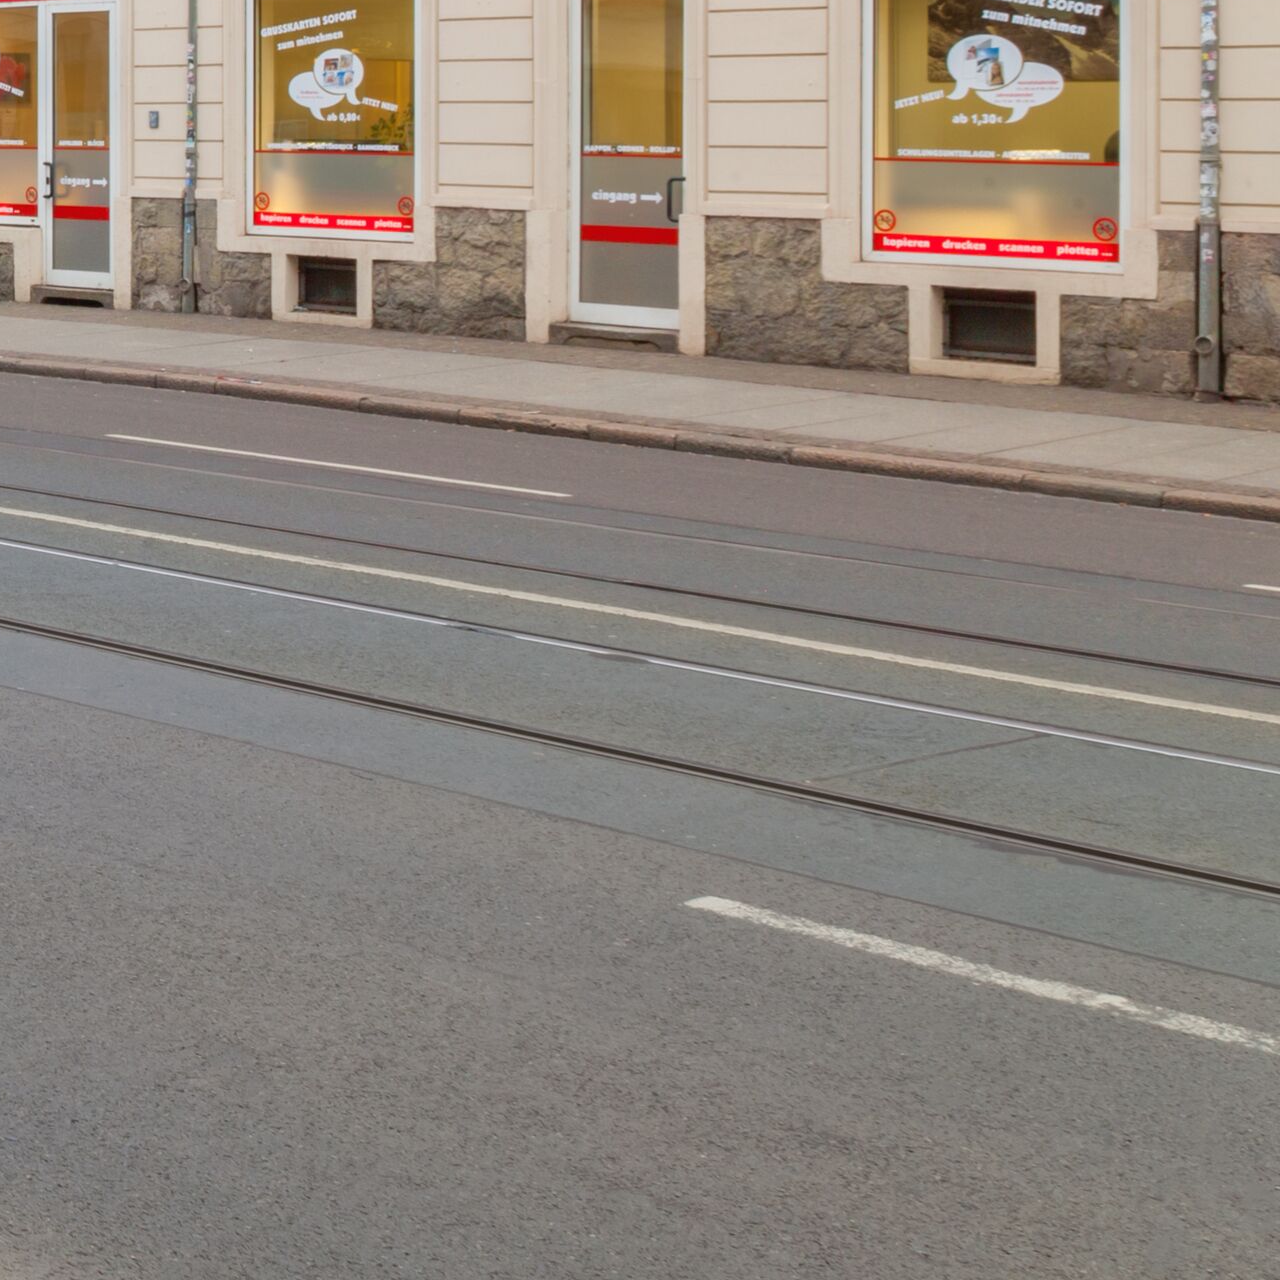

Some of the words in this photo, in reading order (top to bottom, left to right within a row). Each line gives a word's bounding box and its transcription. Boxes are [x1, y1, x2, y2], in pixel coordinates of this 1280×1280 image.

[260, 17, 321, 38] GRUSSKARTEN
[322, 9, 358, 25] SOFORT
[982, 9, 1009, 23] zum
[1011, 13, 1087, 35] mitnehmen
[277, 40, 295, 51] zum
[295, 30, 344, 47] mitnehmen
[327, 113, 338, 122] ab
[952, 114, 968, 124] ab
[591, 189, 637, 204] eingang
[260, 214, 292, 223] kopieren
[299, 215, 329, 225] drucken
[336, 218, 367, 227] scannen
[374, 220, 402, 229] plotten
[882, 236, 930, 249] kopieren
[942, 239, 986, 251] drucken
[998, 243, 1044, 254] scannen
[1056, 244, 1099, 257] plotten
